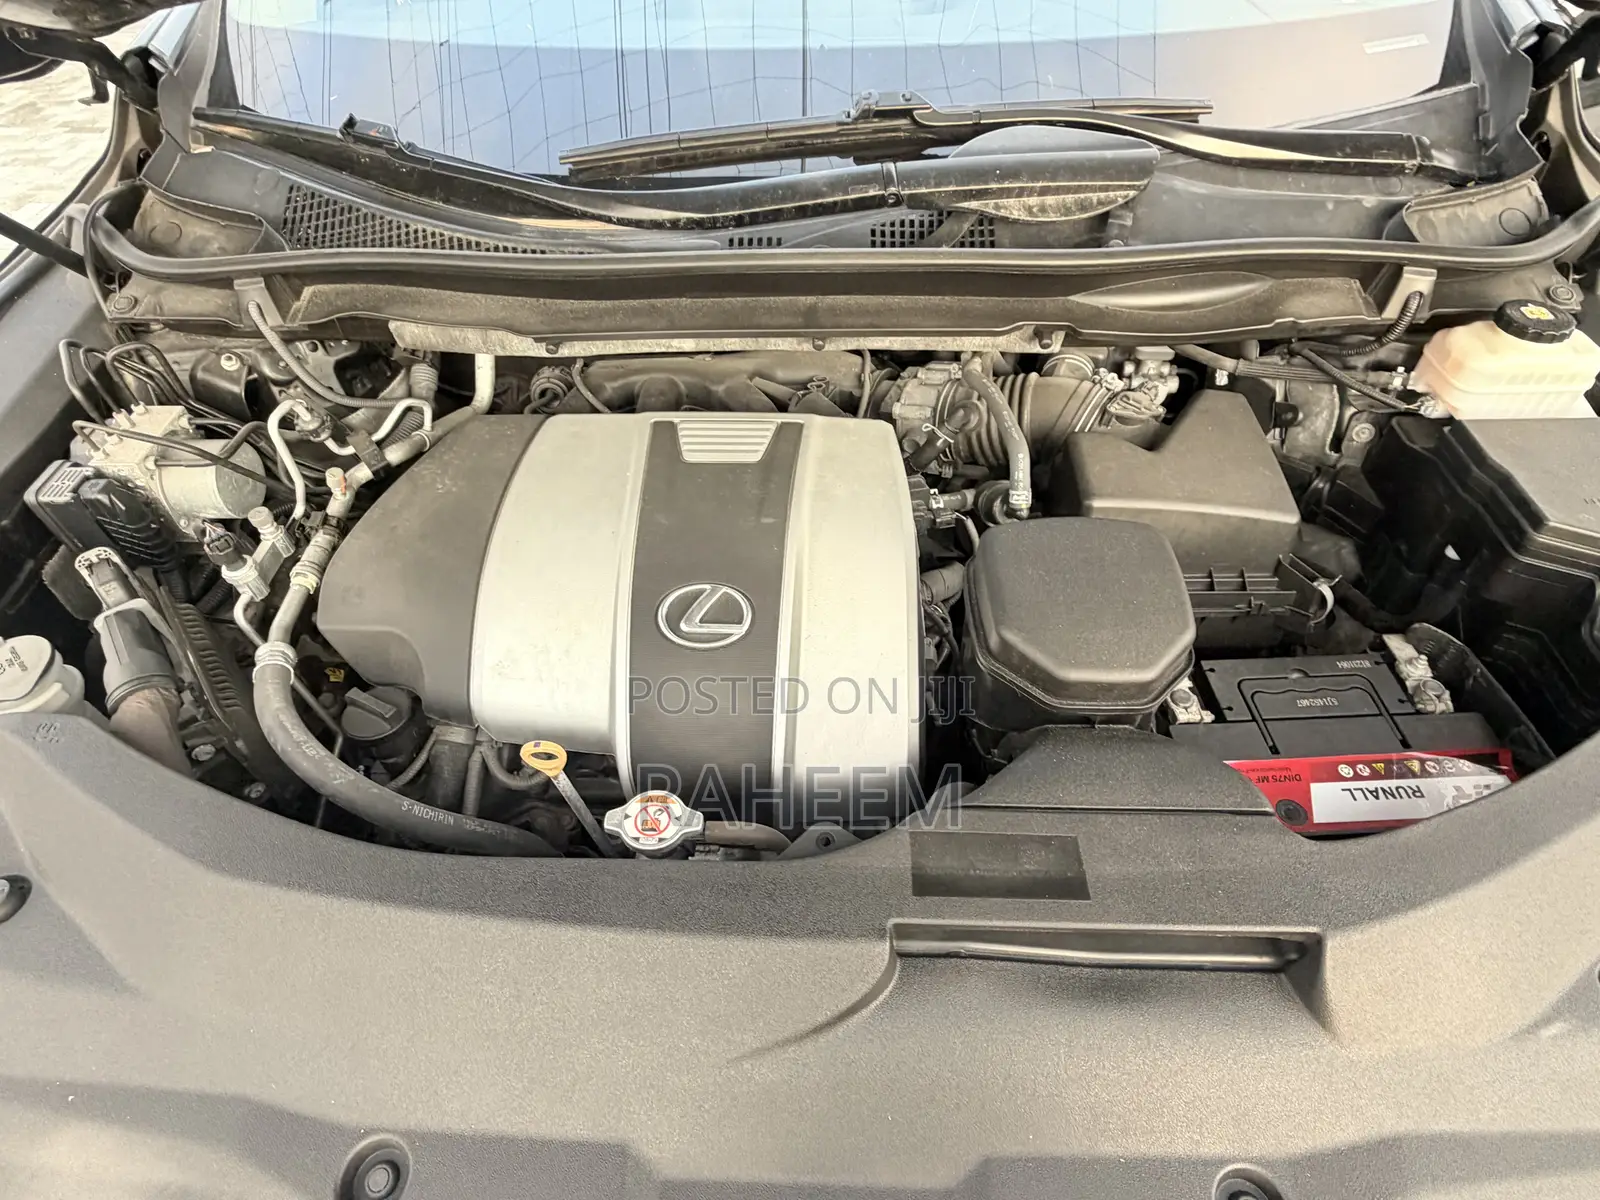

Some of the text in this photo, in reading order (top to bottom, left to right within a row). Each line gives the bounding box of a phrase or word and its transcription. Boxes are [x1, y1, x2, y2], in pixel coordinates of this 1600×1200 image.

[1255, 774, 1302, 783] DIN75 MF
[1340, 784, 1426, 802] RUNALL
